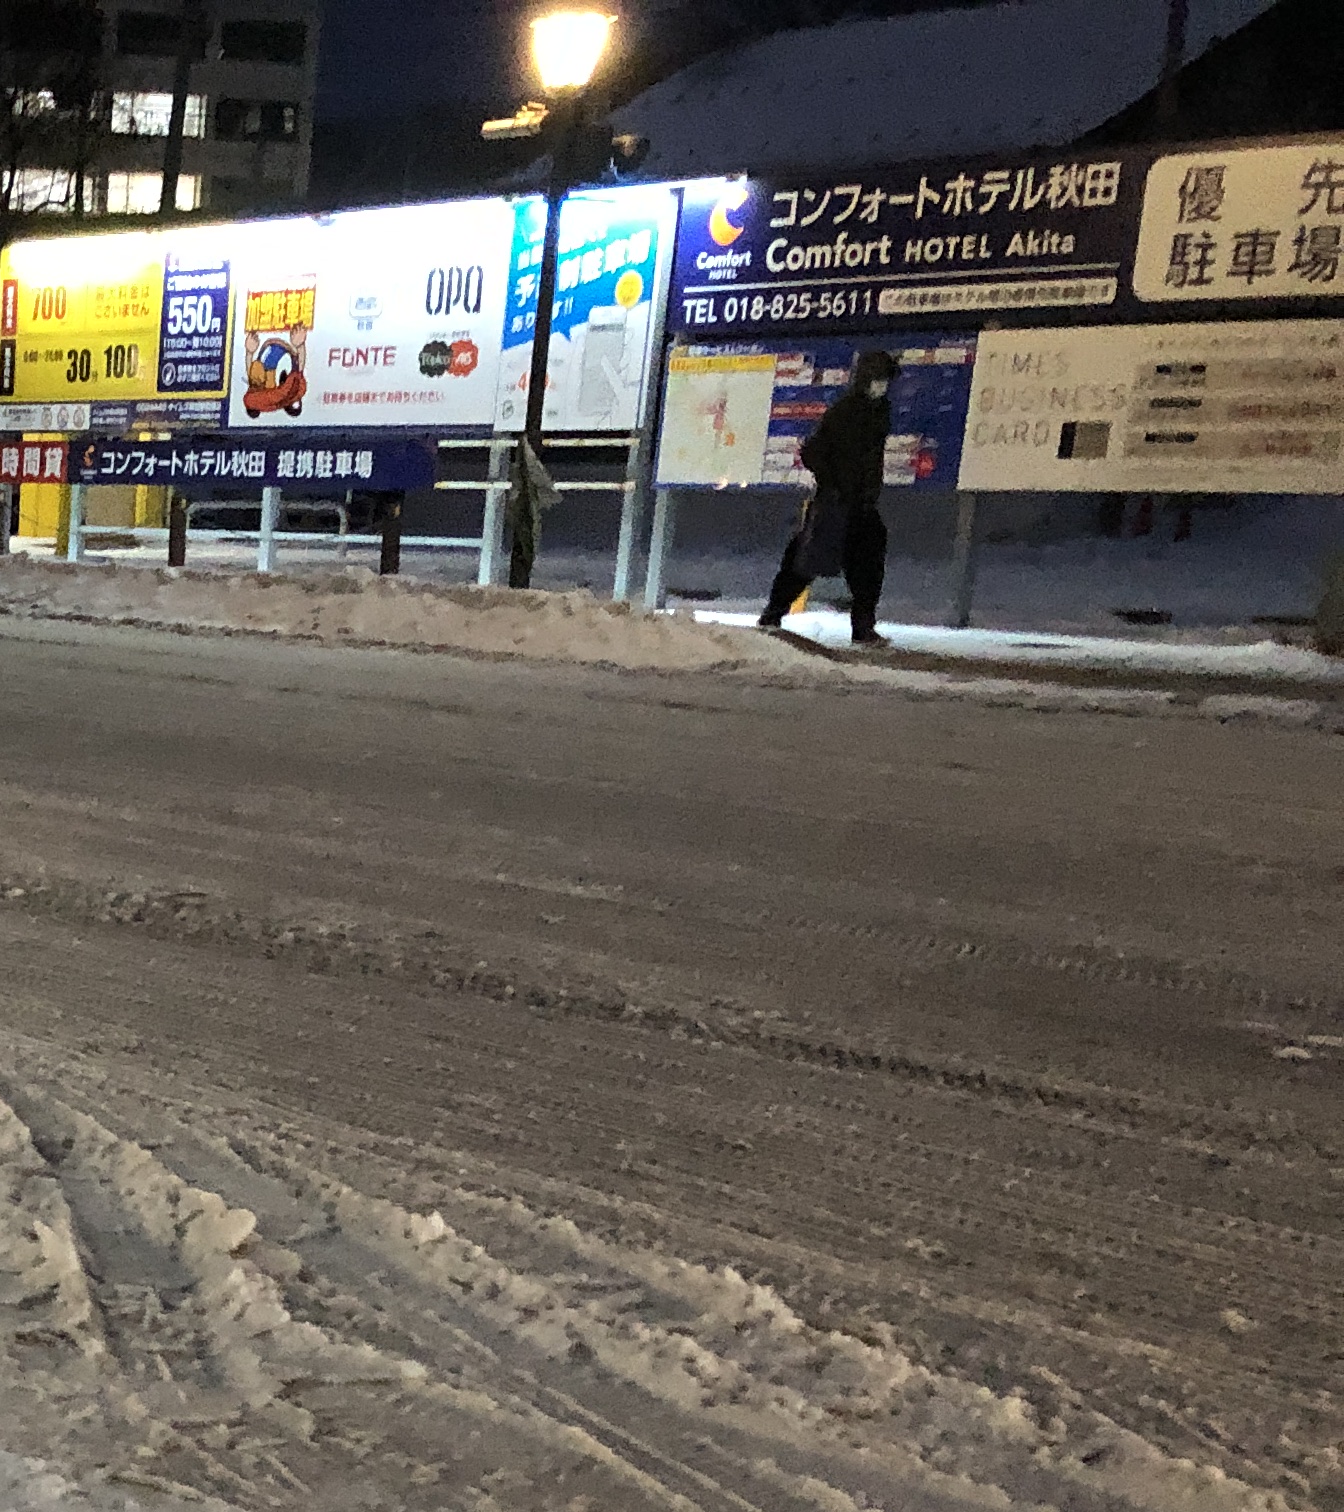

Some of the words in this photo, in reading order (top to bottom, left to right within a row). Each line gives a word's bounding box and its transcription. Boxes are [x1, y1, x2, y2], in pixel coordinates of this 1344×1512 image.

[769, 161, 1122, 230] コンフォートホテル秋田
[696, 249, 752, 270] Comfort
[765, 231, 892, 273] Comfort
[904, 234, 993, 264] HOTEL
[1005, 229, 1076, 258] Akita
[1165, 224, 1342, 288] 駐車場
[683, 297, 717, 325] TEL
[723, 289, 872, 322] 018-825-5611
[328, 346, 398, 368] FONTE
[2, 446, 64, 478] 時間貸
[101, 450, 266, 478] コンフォートホテル秋田
[276, 450, 374, 479] 提携駐車場
